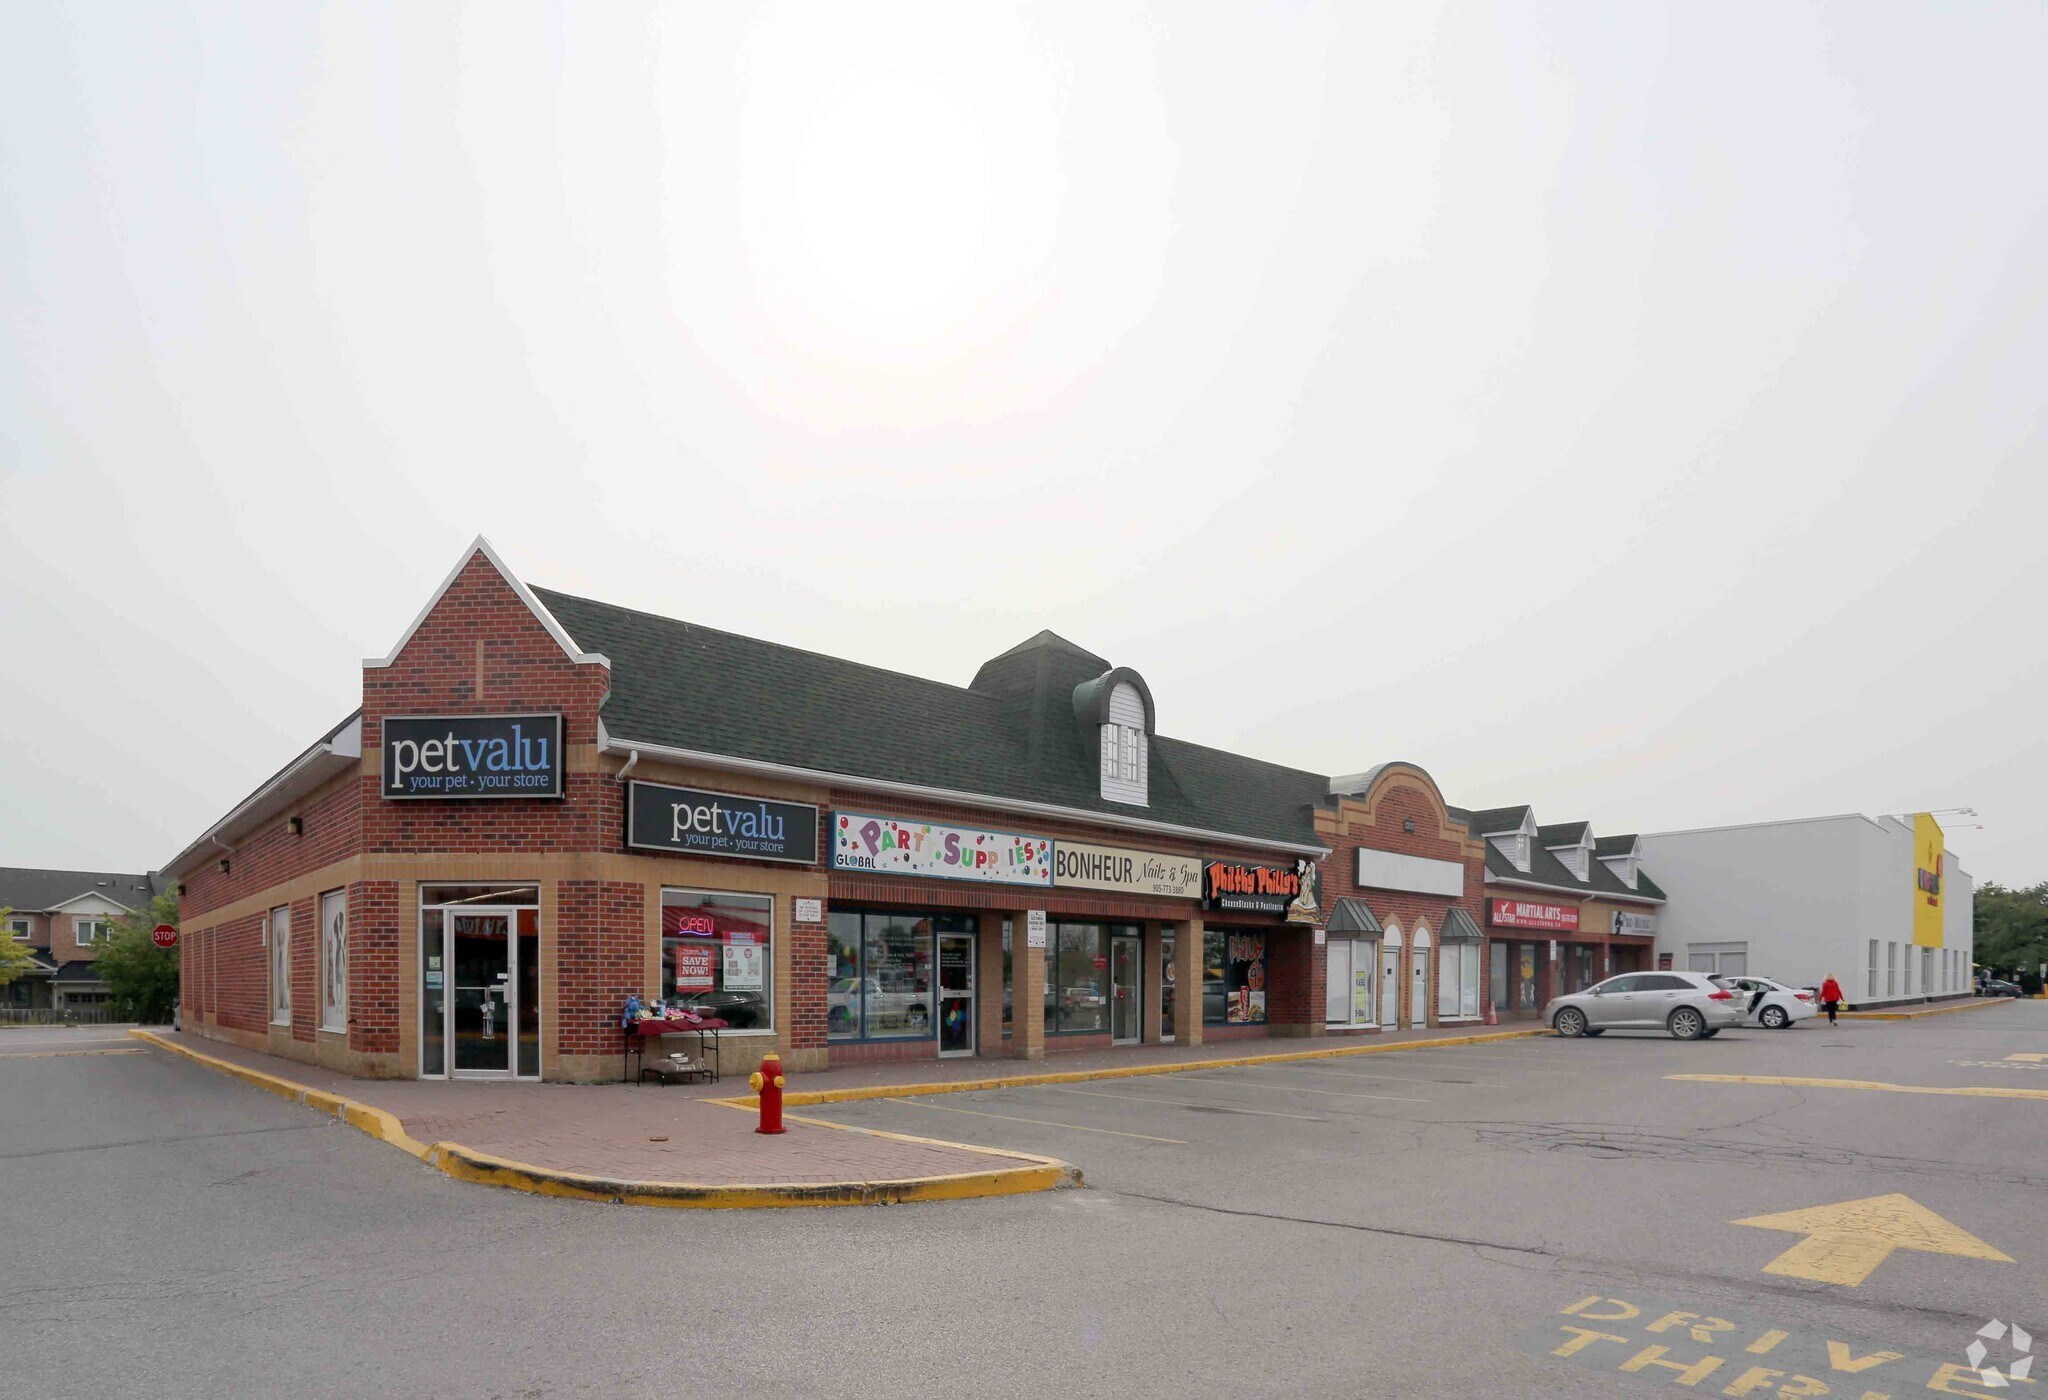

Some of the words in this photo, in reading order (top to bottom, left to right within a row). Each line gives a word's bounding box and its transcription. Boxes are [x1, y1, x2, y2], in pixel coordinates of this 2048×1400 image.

[410, 776, 443, 792] your
[445, 774, 468, 792] pet
[478, 774, 512, 791] your
[513, 773, 549, 787] store
[685, 833, 709, 846] your
[711, 837, 728, 848] pet
[735, 838, 758, 852] your
[761, 841, 784, 853] store
[859, 820, 938, 857] PART
[943, 833, 1034, 870] SUPPIES
[836, 853, 876, 869] GLOBAL
[1056, 850, 1133, 883] BONHEUR
[1136, 858, 1166, 882] Nails
[1168, 867, 1176, 882] &
[1180, 864, 1199, 887] Spa
[1210, 862, 1255, 899] Philthy
[1257, 867, 1298, 895] Philly's
[1516, 903, 1543, 919] MARTIAL
[1544, 907, 1560, 920] ARTS
[679, 917, 714, 932] OPEN
[154, 931, 176, 941] STOP
[681, 966, 709, 975] NOW!
[682, 957, 709, 966] SAVE
[1560, 1295, 2035, 1400] DRIVE
[1551, 1325, 1891, 1400] THR
